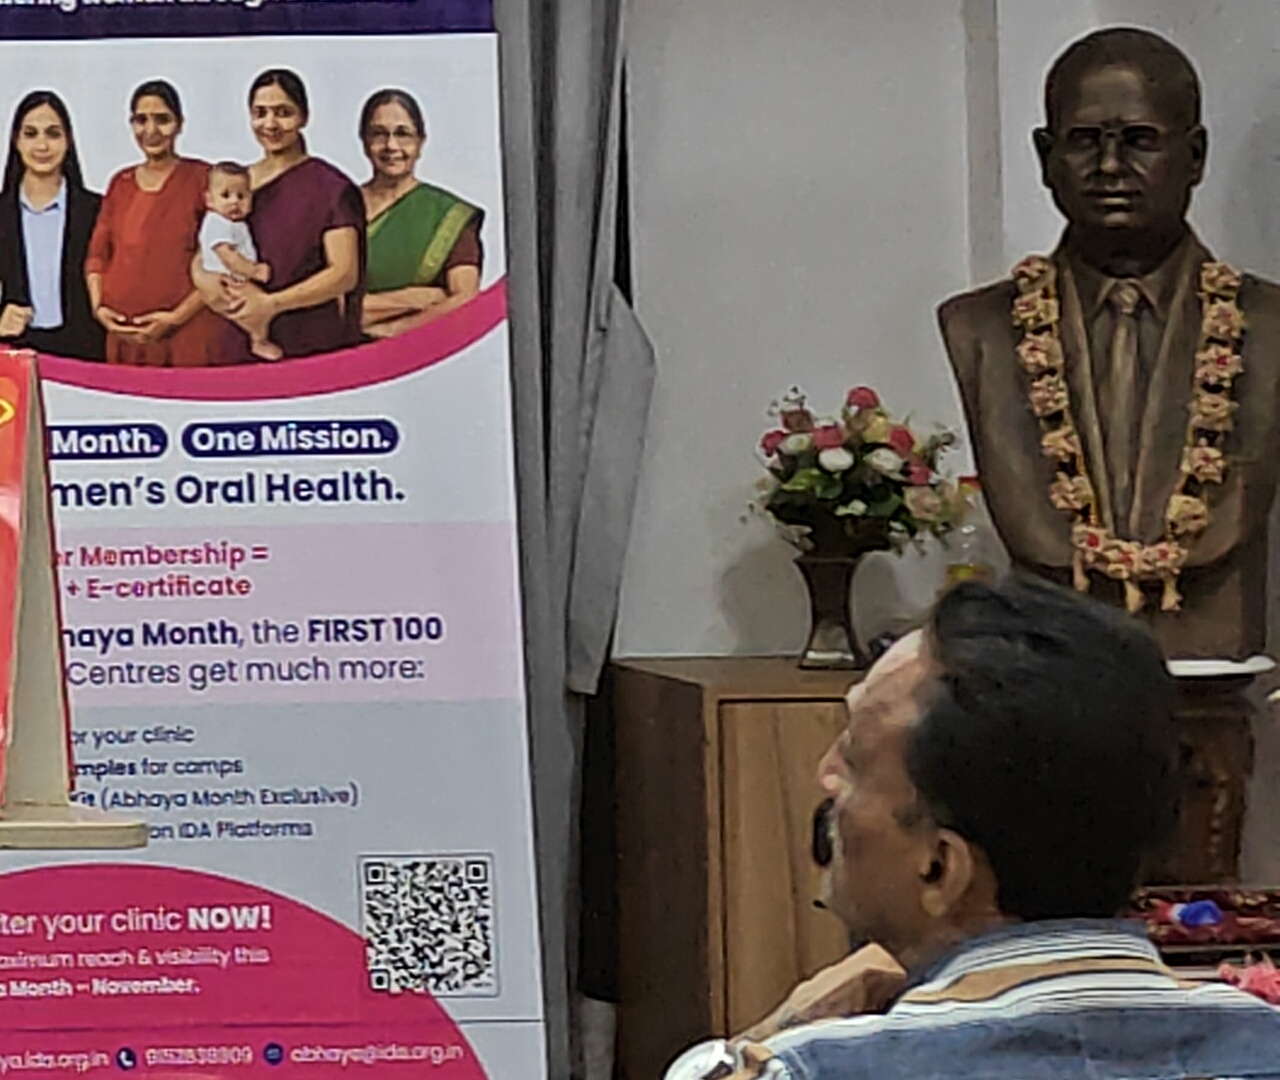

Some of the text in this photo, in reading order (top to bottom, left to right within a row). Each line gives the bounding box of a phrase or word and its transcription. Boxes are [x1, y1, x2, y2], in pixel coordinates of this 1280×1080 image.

[51, 428, 161, 455] Month.
[191, 422, 391, 452] One Mission.
[176, 473, 256, 505] Oral
[266, 470, 406, 503] Health.
[79, 542, 246, 570] Membership
[86, 575, 252, 599] E-certificate
[142, 621, 245, 649] Month,
[252, 620, 300, 643] the
[307, 618, 386, 643] FIRST
[393, 616, 443, 641] 100
[68, 657, 425, 691] Centres get much more:
[92, 730, 138, 750] your
[142, 725, 195, 743] clinic
[141, 757, 169, 776] for
[173, 758, 244, 780] camps
[100, 785, 188, 813] (Abhaya
[192, 787, 256, 807] Month
[259, 781, 360, 808] Exclusive)
[148, 820, 313, 840] on IDA Platforms
[44, 913, 106, 941] your
[110, 907, 183, 934] clinic
[187, 904, 273, 932] NOW!
[77, 948, 135, 967] reach
[155, 946, 231, 968] visibility
[233, 945, 270, 964] this
[8, 977, 74, 998] Month
[90, 975, 201, 996] November.
